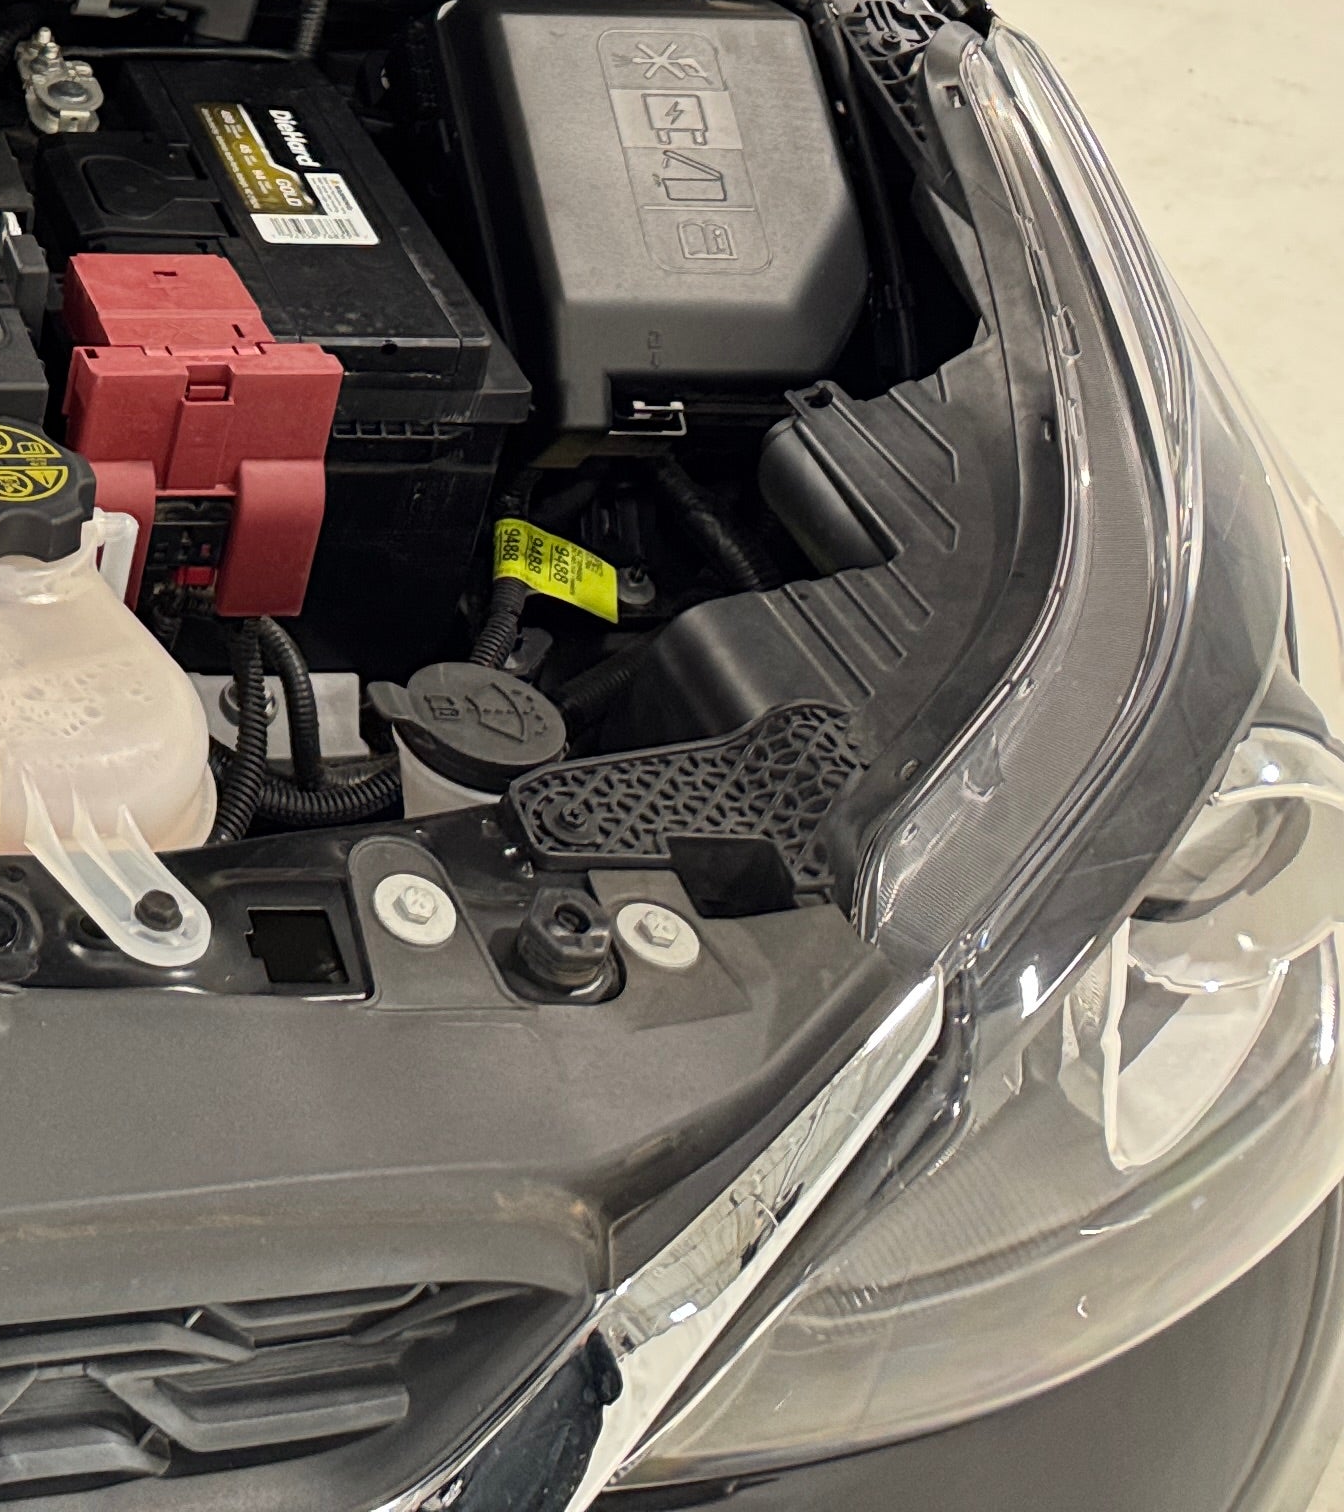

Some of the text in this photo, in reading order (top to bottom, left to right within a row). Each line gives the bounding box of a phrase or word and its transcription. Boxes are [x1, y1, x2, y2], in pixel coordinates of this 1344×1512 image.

[268, 109, 322, 168] DieHard
[275, 178, 304, 207] GOLD
[502, 528, 522, 562] 9488
[527, 537, 544, 575] 9488
[553, 545, 570, 584] 9488
